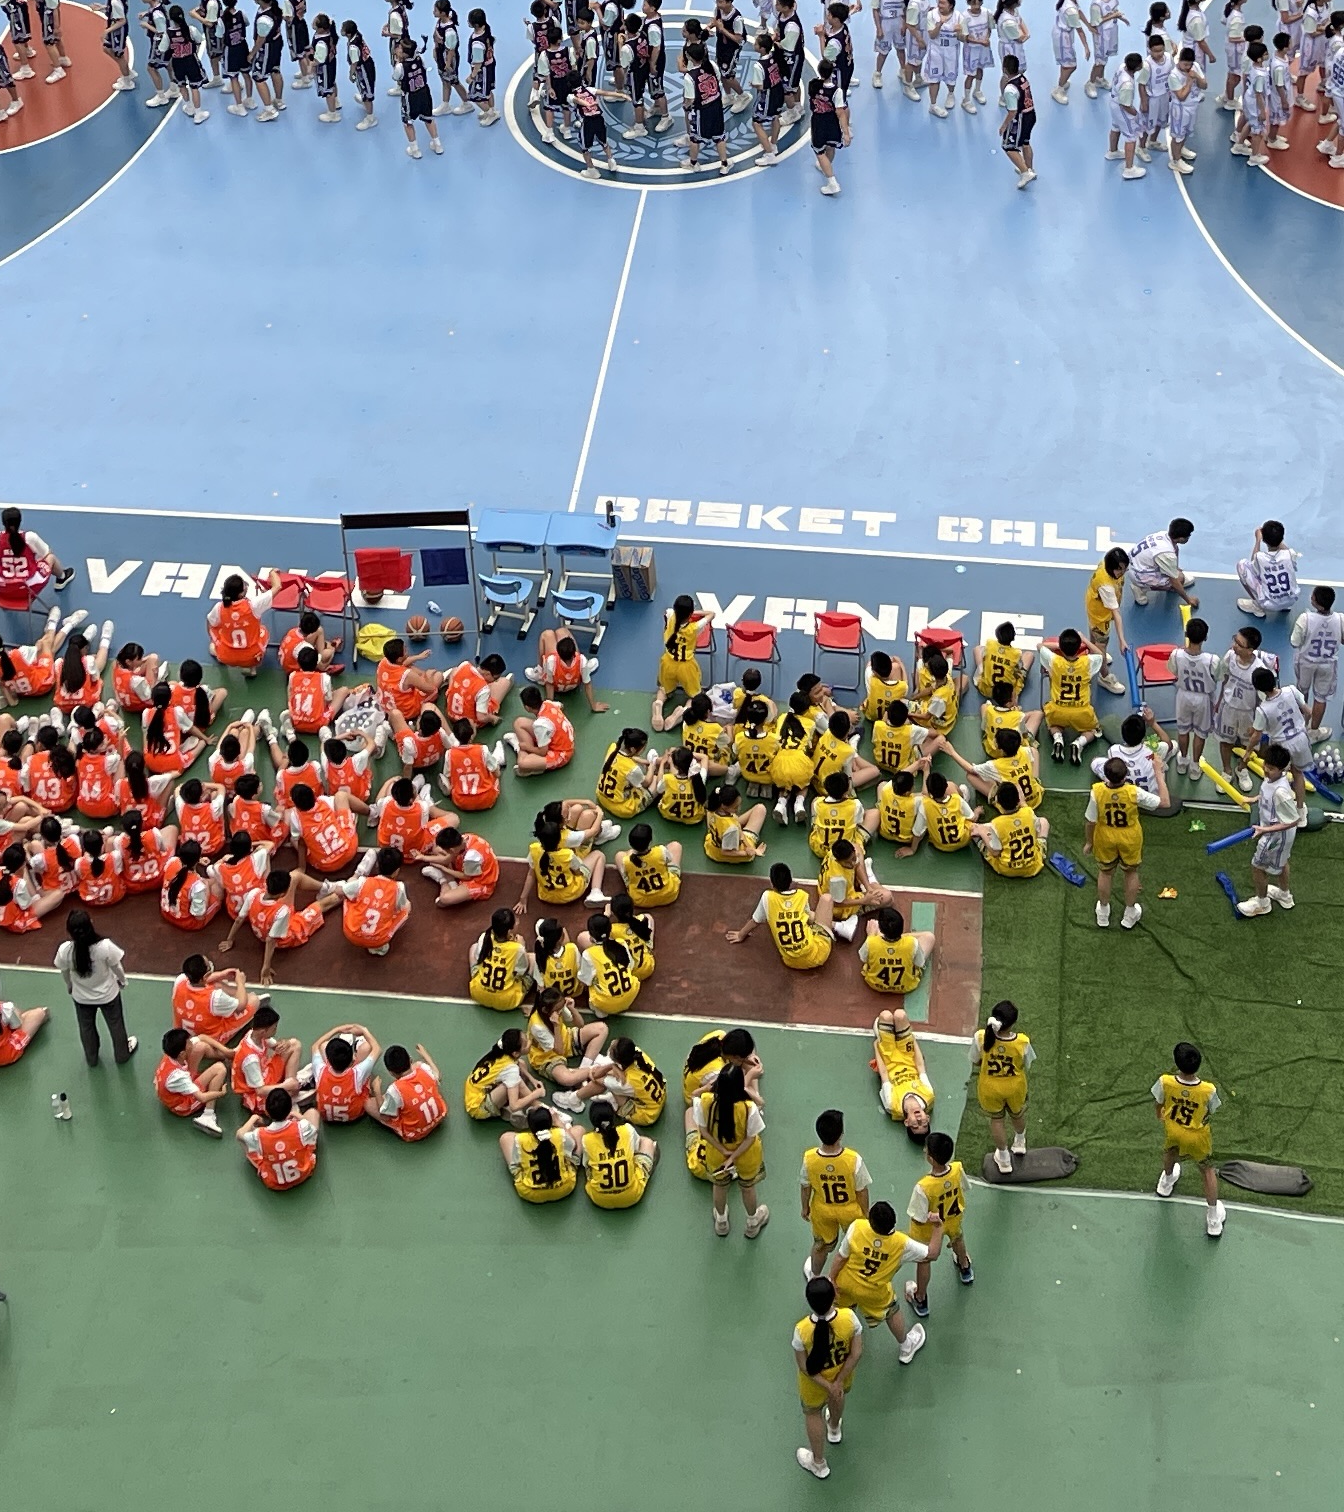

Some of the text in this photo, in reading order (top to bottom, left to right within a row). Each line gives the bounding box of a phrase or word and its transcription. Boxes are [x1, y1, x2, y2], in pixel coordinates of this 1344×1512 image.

[596, 495, 897, 537] BASKET
[2, 556, 28, 577] 52
[1264, 572, 1290, 594] 29
[232, 630, 247, 648] 0
[1309, 639, 1337, 658] 35
[992, 664, 1004, 682] 2
[1060, 681, 1080, 700] 21
[294, 694, 313, 714] 14
[881, 748, 902, 769] 10
[79, 780, 101, 801] 44
[460, 773, 480, 794] 17
[1018, 775, 1032, 794] 8
[669, 801, 694, 819] 43
[1106, 810, 1128, 827] 18
[887, 816, 901, 835] 3
[938, 824, 959, 844] 12
[318, 826, 344, 854] 12
[824, 828, 844, 849] 17
[1009, 835, 1035, 861] 22
[637, 874, 663, 893] 40
[363, 908, 378, 932] 3
[776, 920, 805, 946] 20
[481, 964, 506, 990] 38
[604, 970, 631, 996] 26
[877, 966, 905, 986] 47
[324, 1103, 349, 1122] 15
[419, 1098, 440, 1124] 11
[1170, 1106, 1194, 1126] 15
[272, 1160, 300, 1185] 16
[599, 1160, 629, 1189] 30
[822, 1183, 848, 1204] 16
